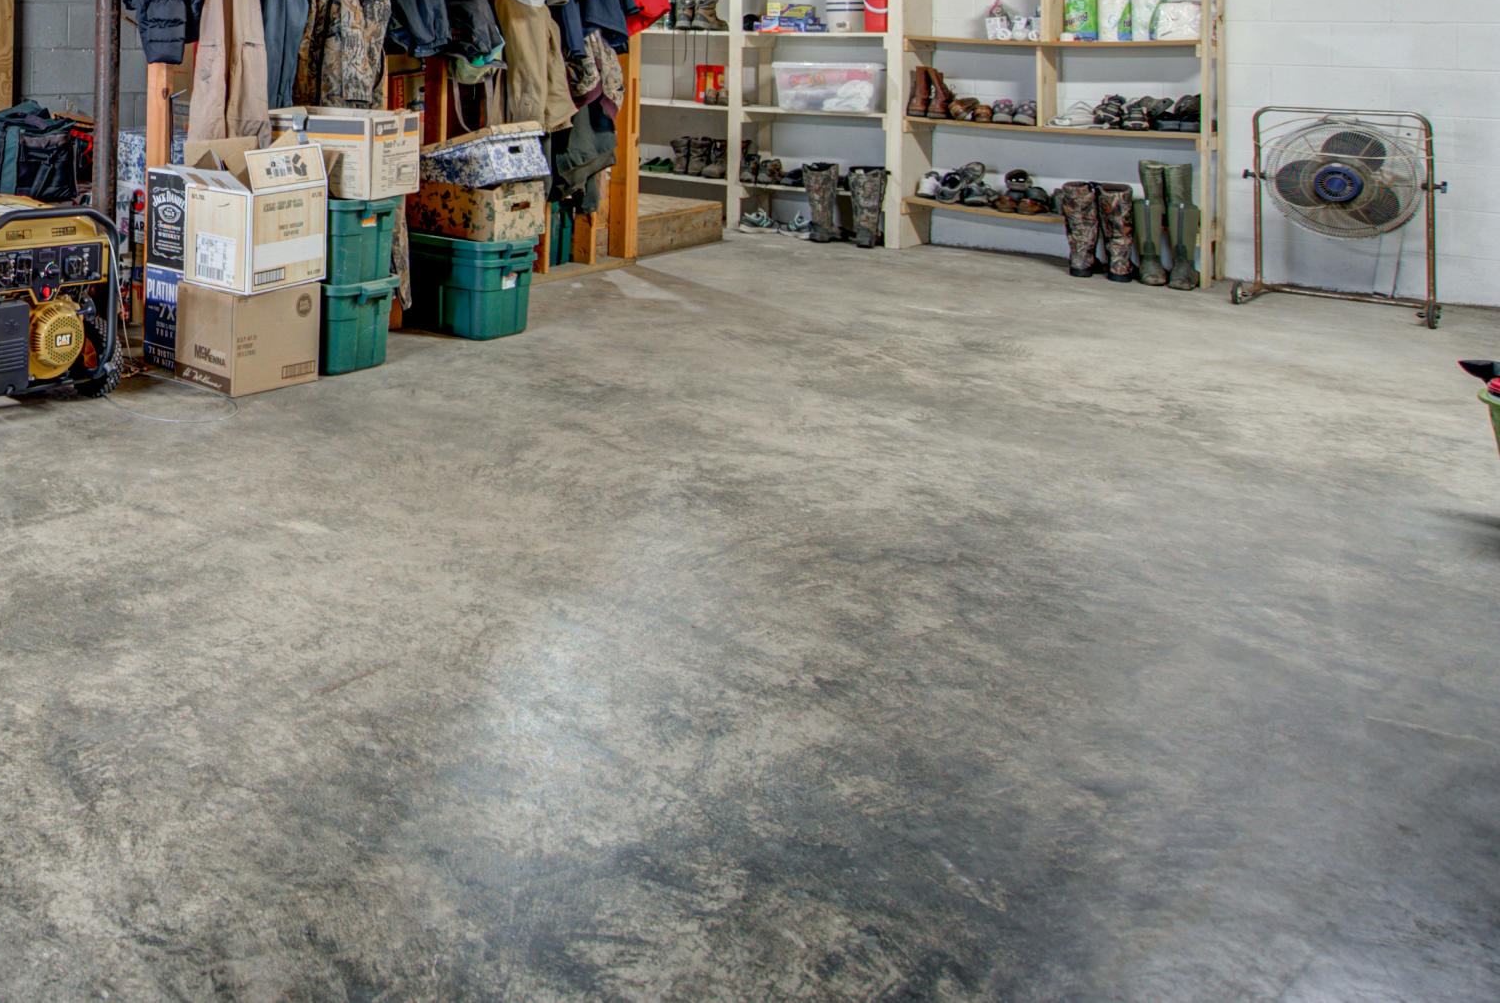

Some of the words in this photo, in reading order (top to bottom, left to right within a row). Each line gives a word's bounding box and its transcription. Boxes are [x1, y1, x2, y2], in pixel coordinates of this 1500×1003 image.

[152, 193, 166, 208] JACK
[159, 302, 175, 322] 7X
[56, 333, 72, 347] CAT
